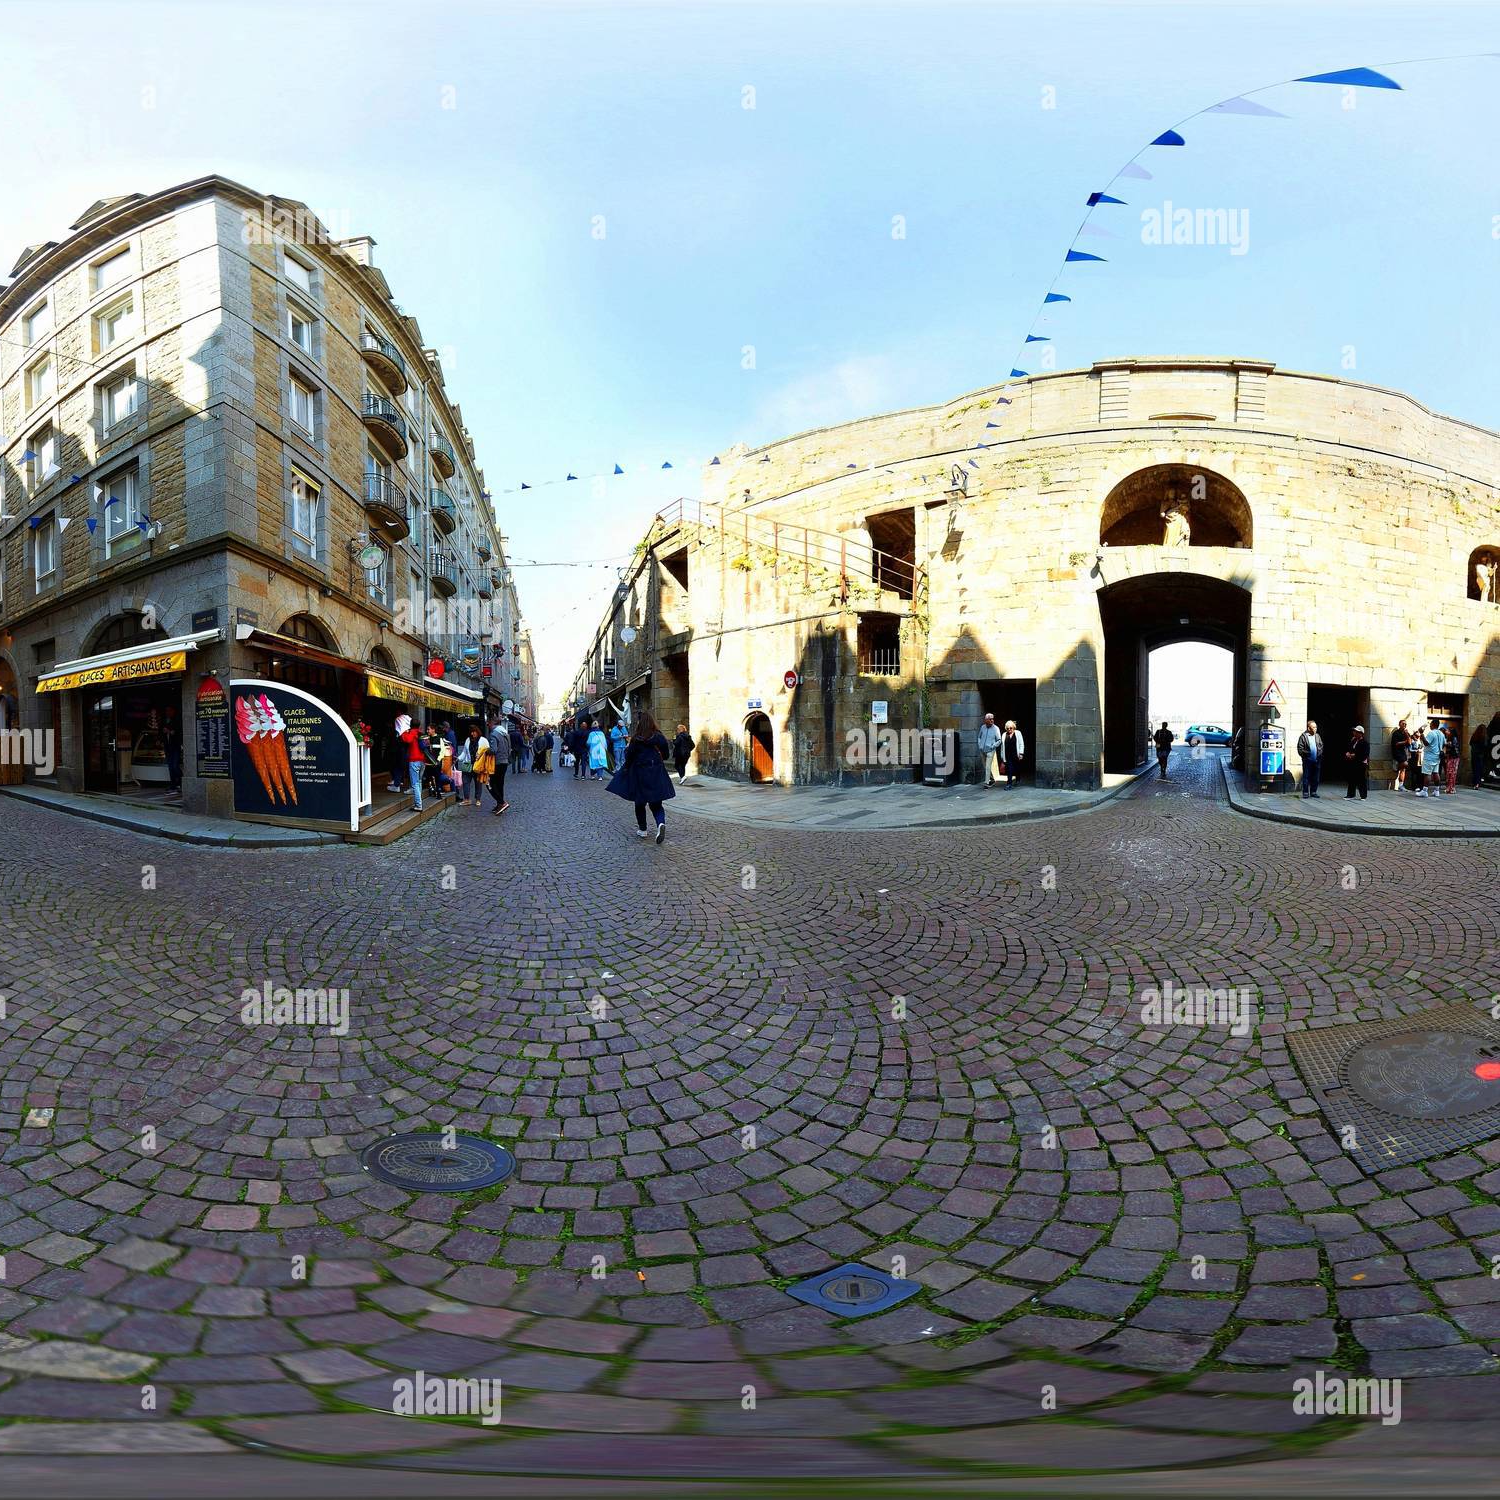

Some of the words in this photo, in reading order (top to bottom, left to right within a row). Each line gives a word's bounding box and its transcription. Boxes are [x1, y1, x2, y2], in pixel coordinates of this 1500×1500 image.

[79, 669, 105, 684] GLACES
[112, 657, 172, 679] ARTISANALES
[288, 717, 322, 725] ITALIENNES
